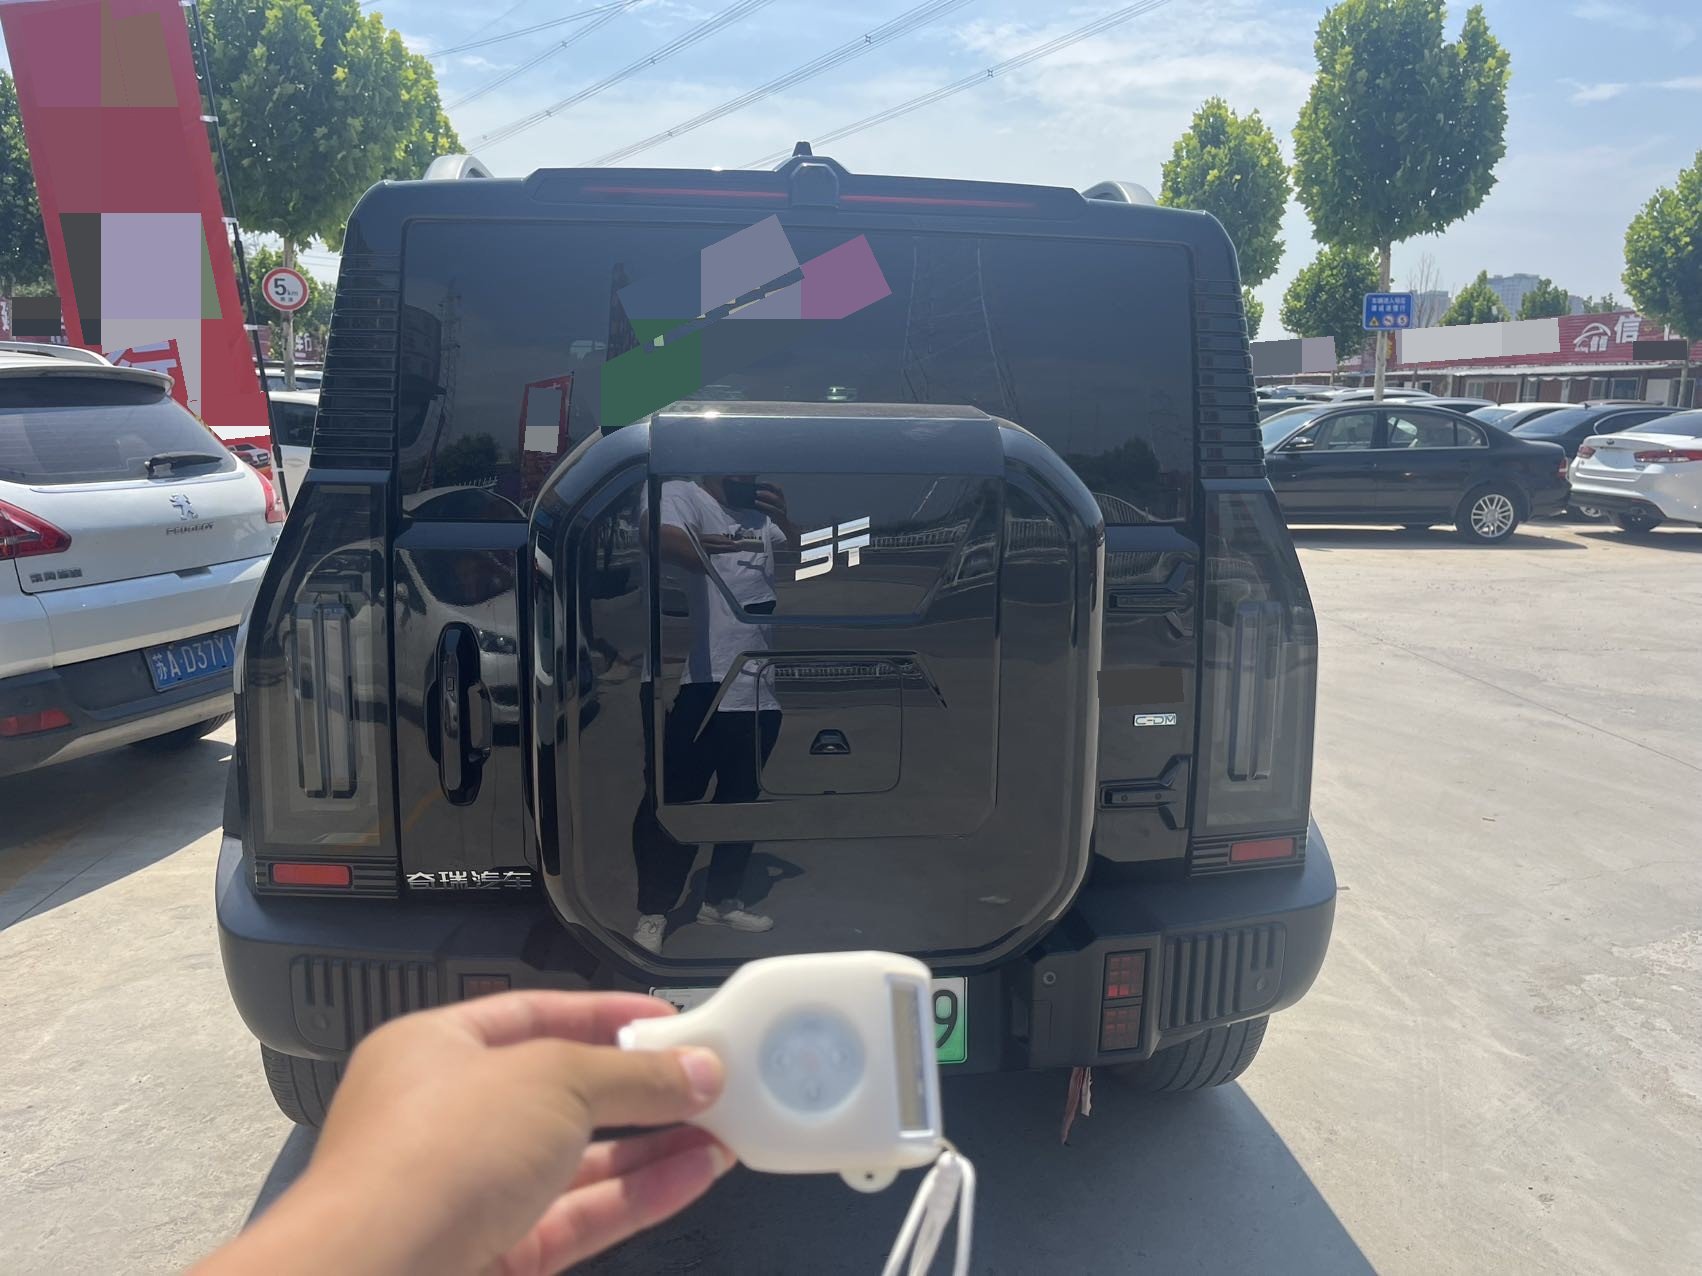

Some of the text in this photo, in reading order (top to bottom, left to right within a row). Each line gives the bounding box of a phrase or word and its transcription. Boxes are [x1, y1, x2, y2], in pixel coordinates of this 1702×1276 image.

[1614, 315, 1642, 344] 信
[406, 871, 532, 890] 奇瑞汽车
